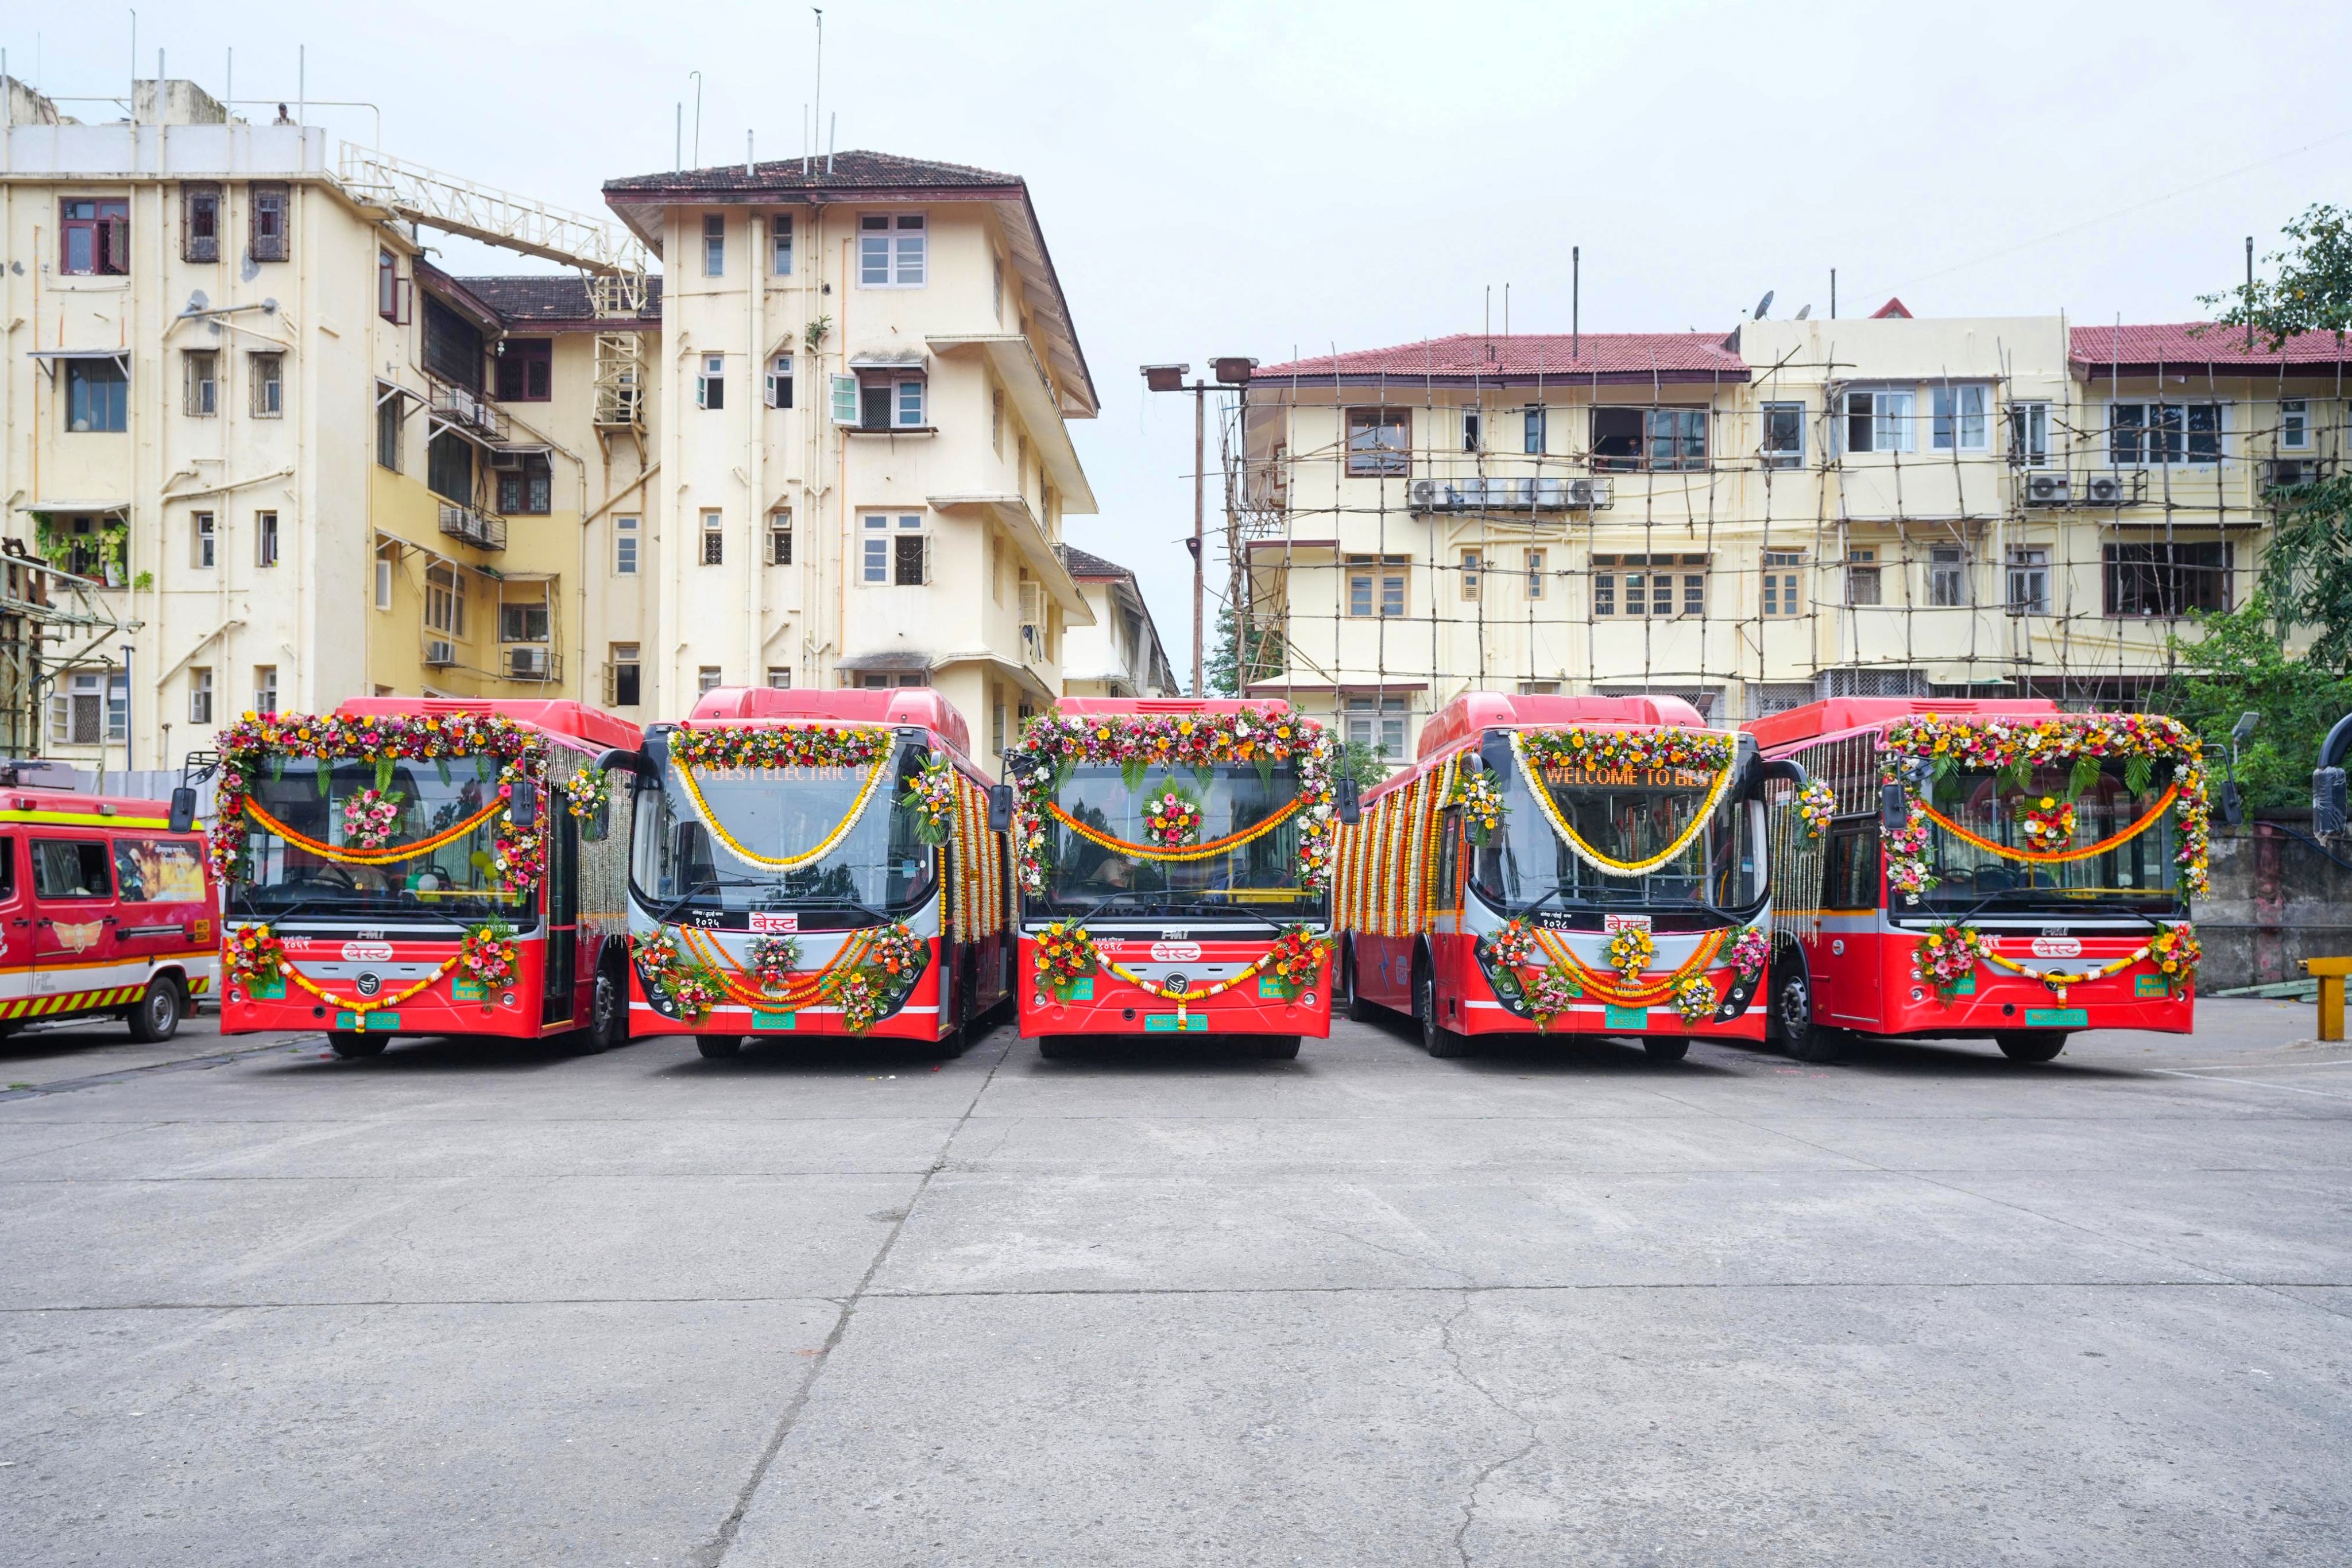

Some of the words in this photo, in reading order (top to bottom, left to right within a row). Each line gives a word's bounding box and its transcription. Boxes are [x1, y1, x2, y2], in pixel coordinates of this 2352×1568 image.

[763, 763, 848, 781] ELECTRIC
[1545, 766, 1638, 785] WELCOME
[1647, 769, 1670, 786] TO
[1675, 769, 1720, 787] BEST
[695, 917, 719, 928] १०२५
[751, 913, 797, 931] बेस्ट
[1544, 919, 1567, 930] १०२८
[357, 930, 385, 939] PMI
[1161, 930, 1189, 940] PMI
[1097, 942, 1122, 951] ४०६८
[1979, 939, 1999, 948] ०६६
[2034, 939, 2078, 954] बेस्ट
[345, 944, 389, 959] बेस्ट
[1152, 943, 1198, 959] बेस्ट
[1152, 1017, 1205, 1028] MH01F320
